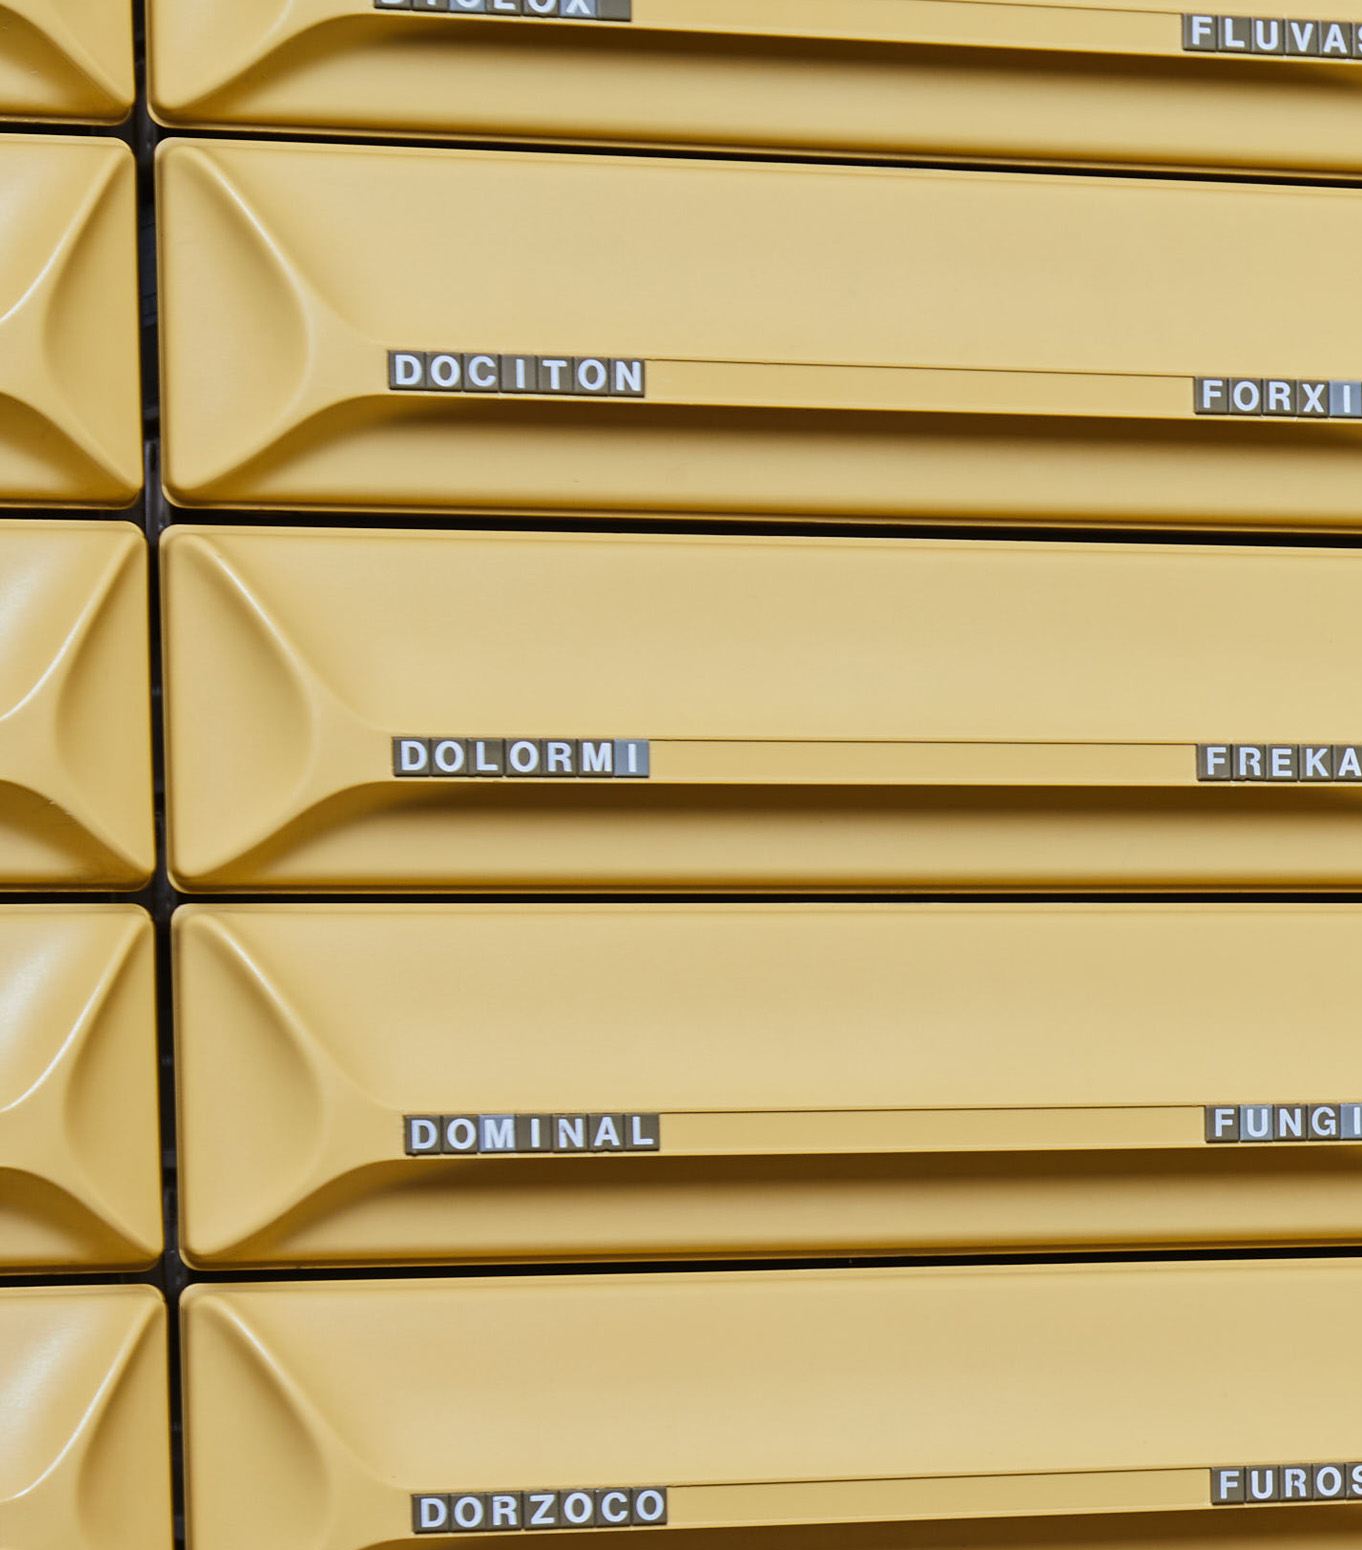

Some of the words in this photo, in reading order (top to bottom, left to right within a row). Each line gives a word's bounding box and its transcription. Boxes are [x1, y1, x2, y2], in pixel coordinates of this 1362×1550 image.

[395, 354, 641, 392] DOCITON
[401, 740, 638, 773] DOLORMI
[1206, 746, 1362, 777] FREKA
[411, 1116, 654, 1150] DOMINAL
[420, 1490, 664, 1528] DORZOCO
